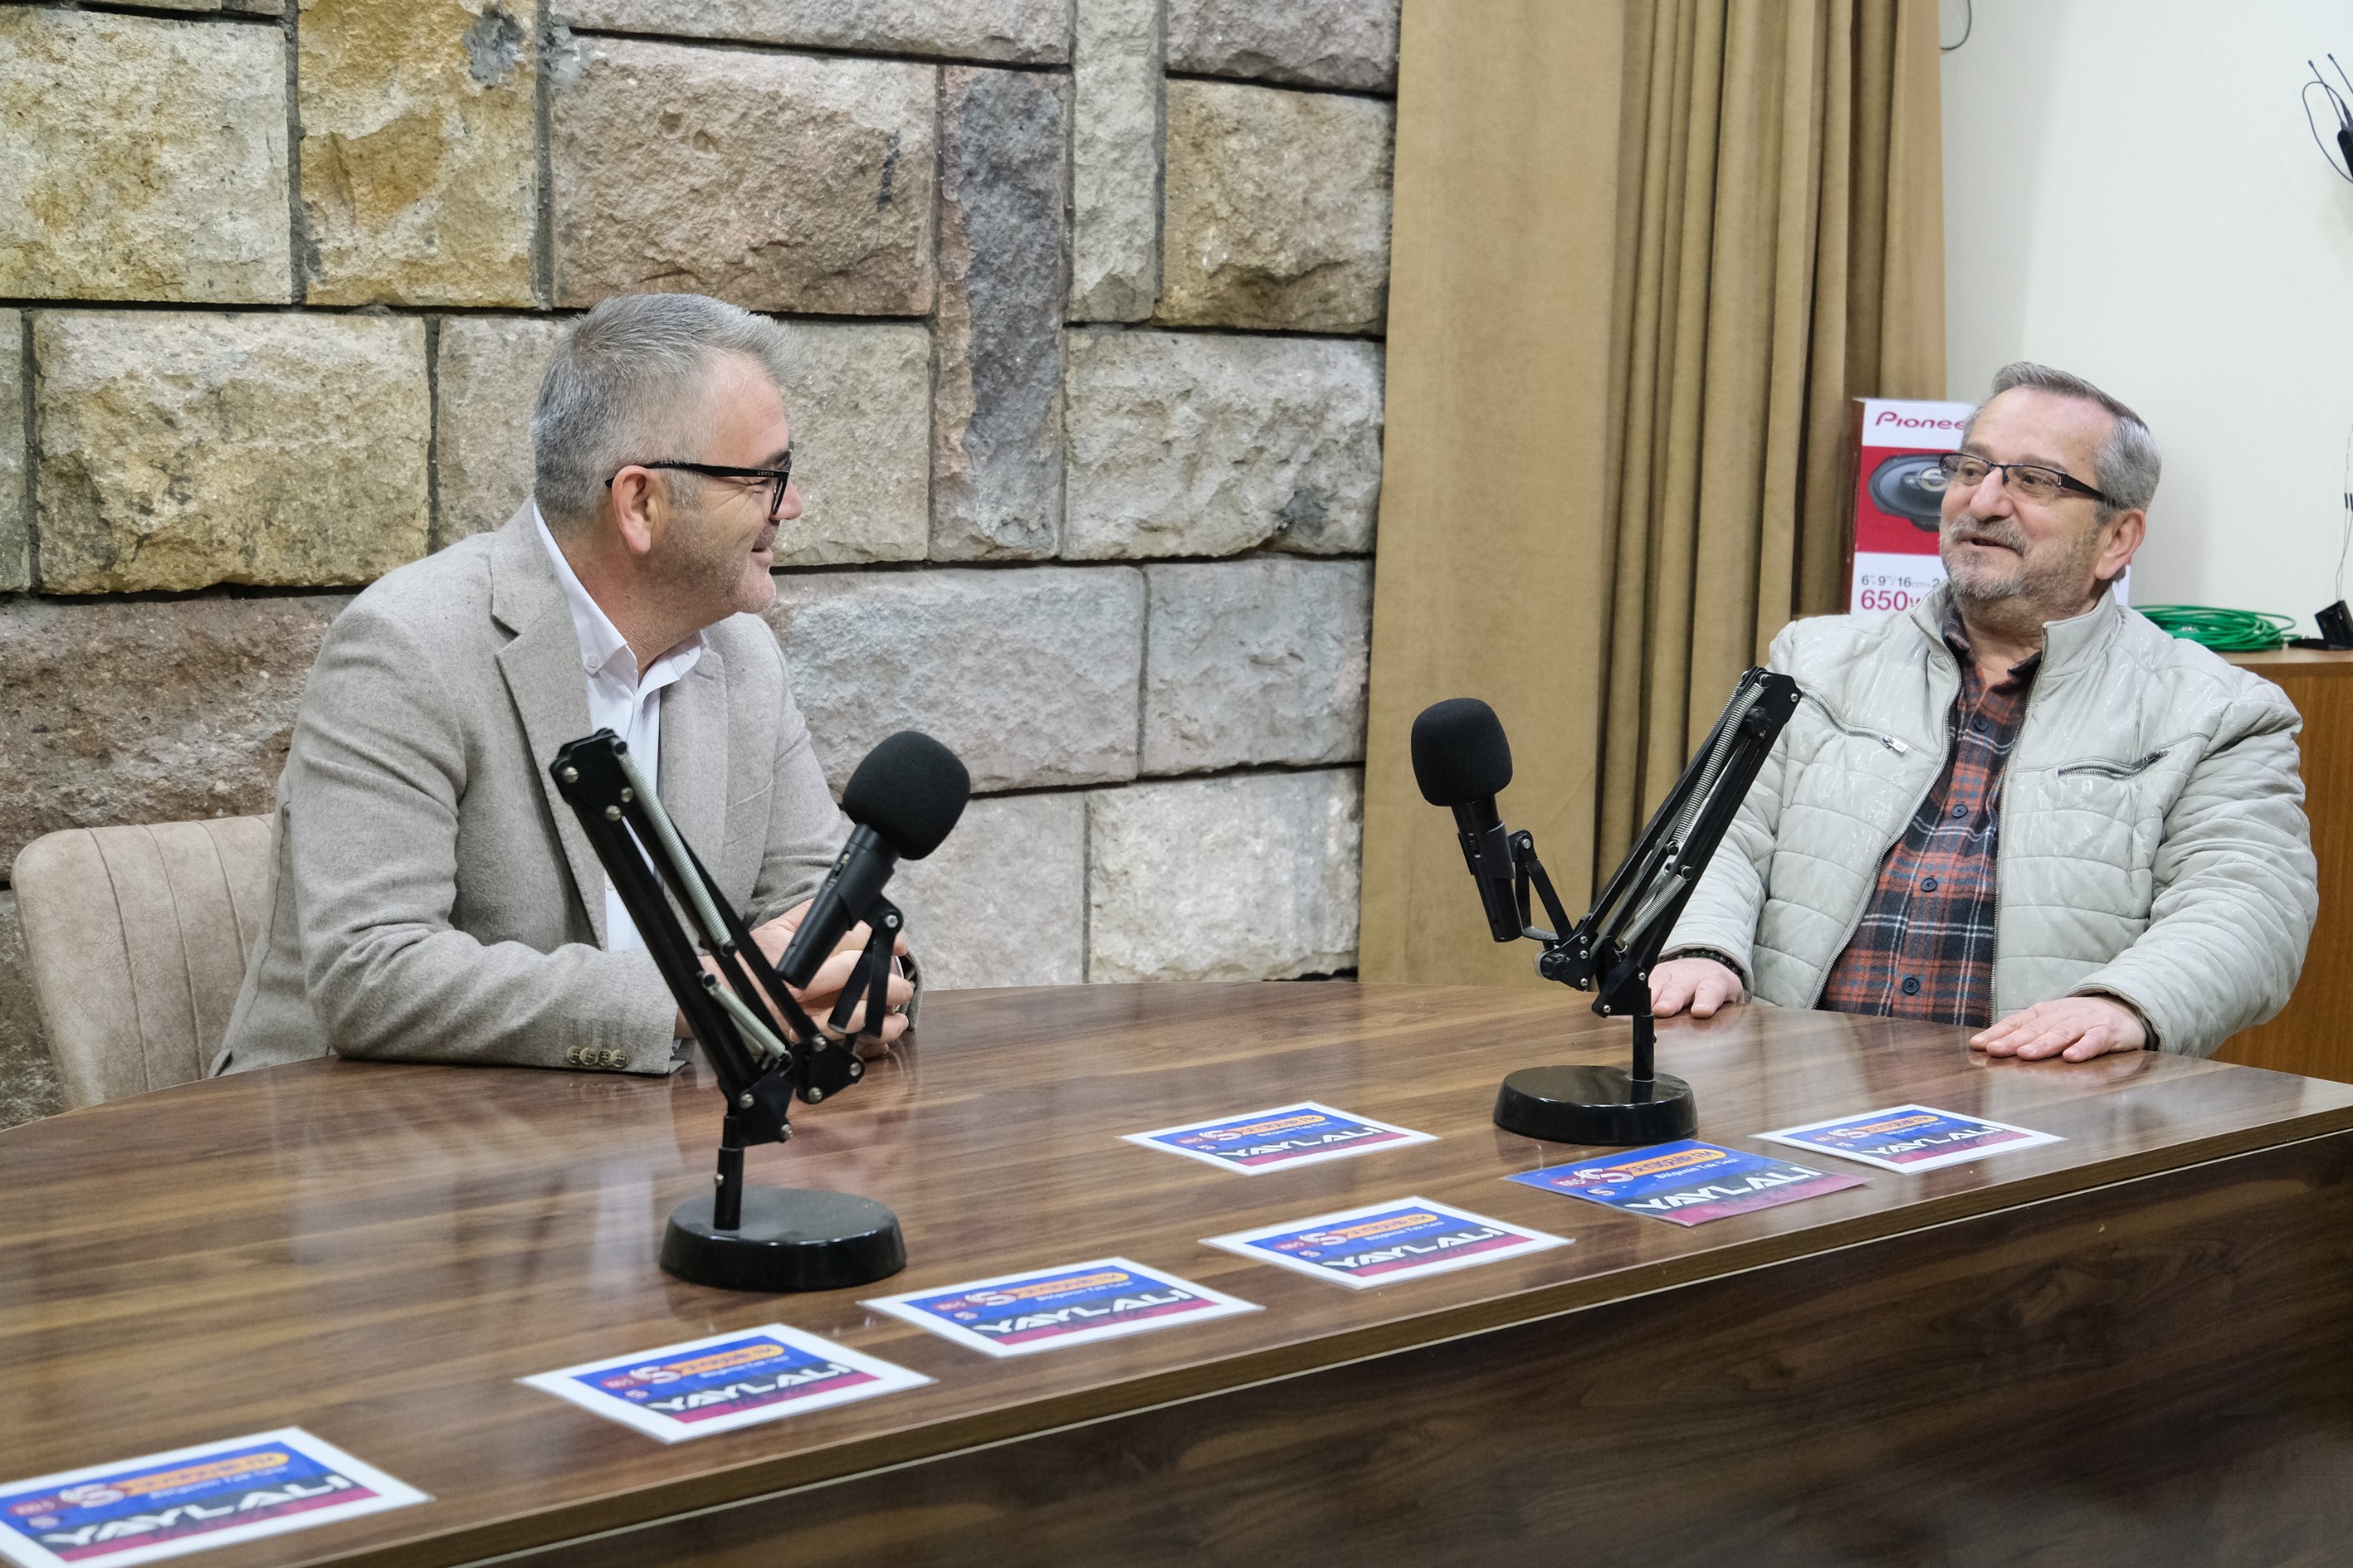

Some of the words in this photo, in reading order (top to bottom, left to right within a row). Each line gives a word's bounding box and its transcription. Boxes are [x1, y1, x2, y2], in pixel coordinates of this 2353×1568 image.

[1875, 411, 1965, 430] Pionee
[1216, 1127, 1385, 1157] YAYLALI
[1860, 1126, 2004, 1155] YAYLALI
[1626, 1166, 1824, 1210] YAYLALI
[1322, 1227, 1506, 1268] YAYLALI
[971, 1289, 1193, 1334] YAYLALI
[646, 1363, 852, 1412] YAYLALI
[40, 1473, 355, 1547] YAYLALI
